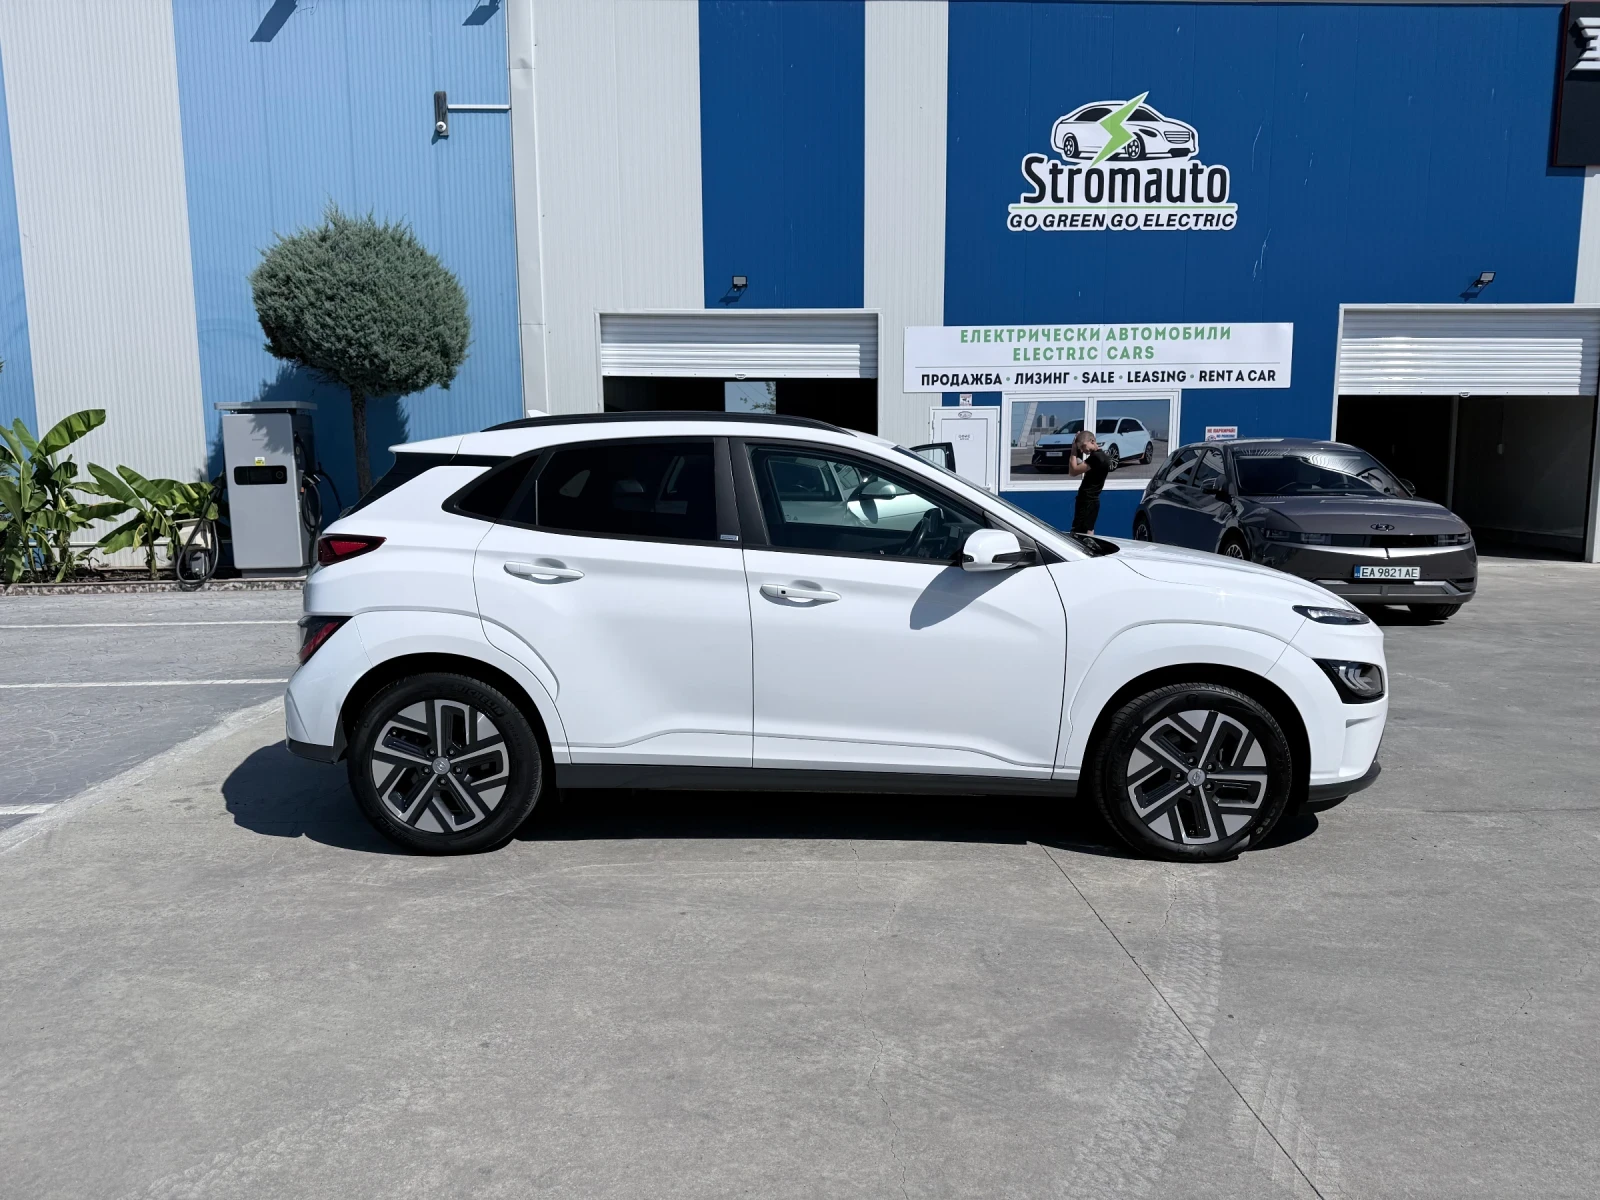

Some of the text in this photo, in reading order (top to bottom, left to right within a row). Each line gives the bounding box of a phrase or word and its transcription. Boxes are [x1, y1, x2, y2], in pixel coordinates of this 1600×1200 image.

[1023, 156, 1227, 204] Stromauto
[1010, 213, 1235, 228] GO GREEN GO ELECTRIC
[960, 326, 1232, 344] ЕЛЕКТРИЧЕСКИ АВТОМОБИЛИ
[1013, 345, 1155, 362] ELECTRIC CARS
[921, 369, 1276, 387] ПРОДАЖБА ЛИЗИНГ SALE LEASING RENT A CAR
[1361, 567, 1376, 577] EA
[1378, 567, 1402, 577] 9821
[1404, 568, 1418, 578] AE
